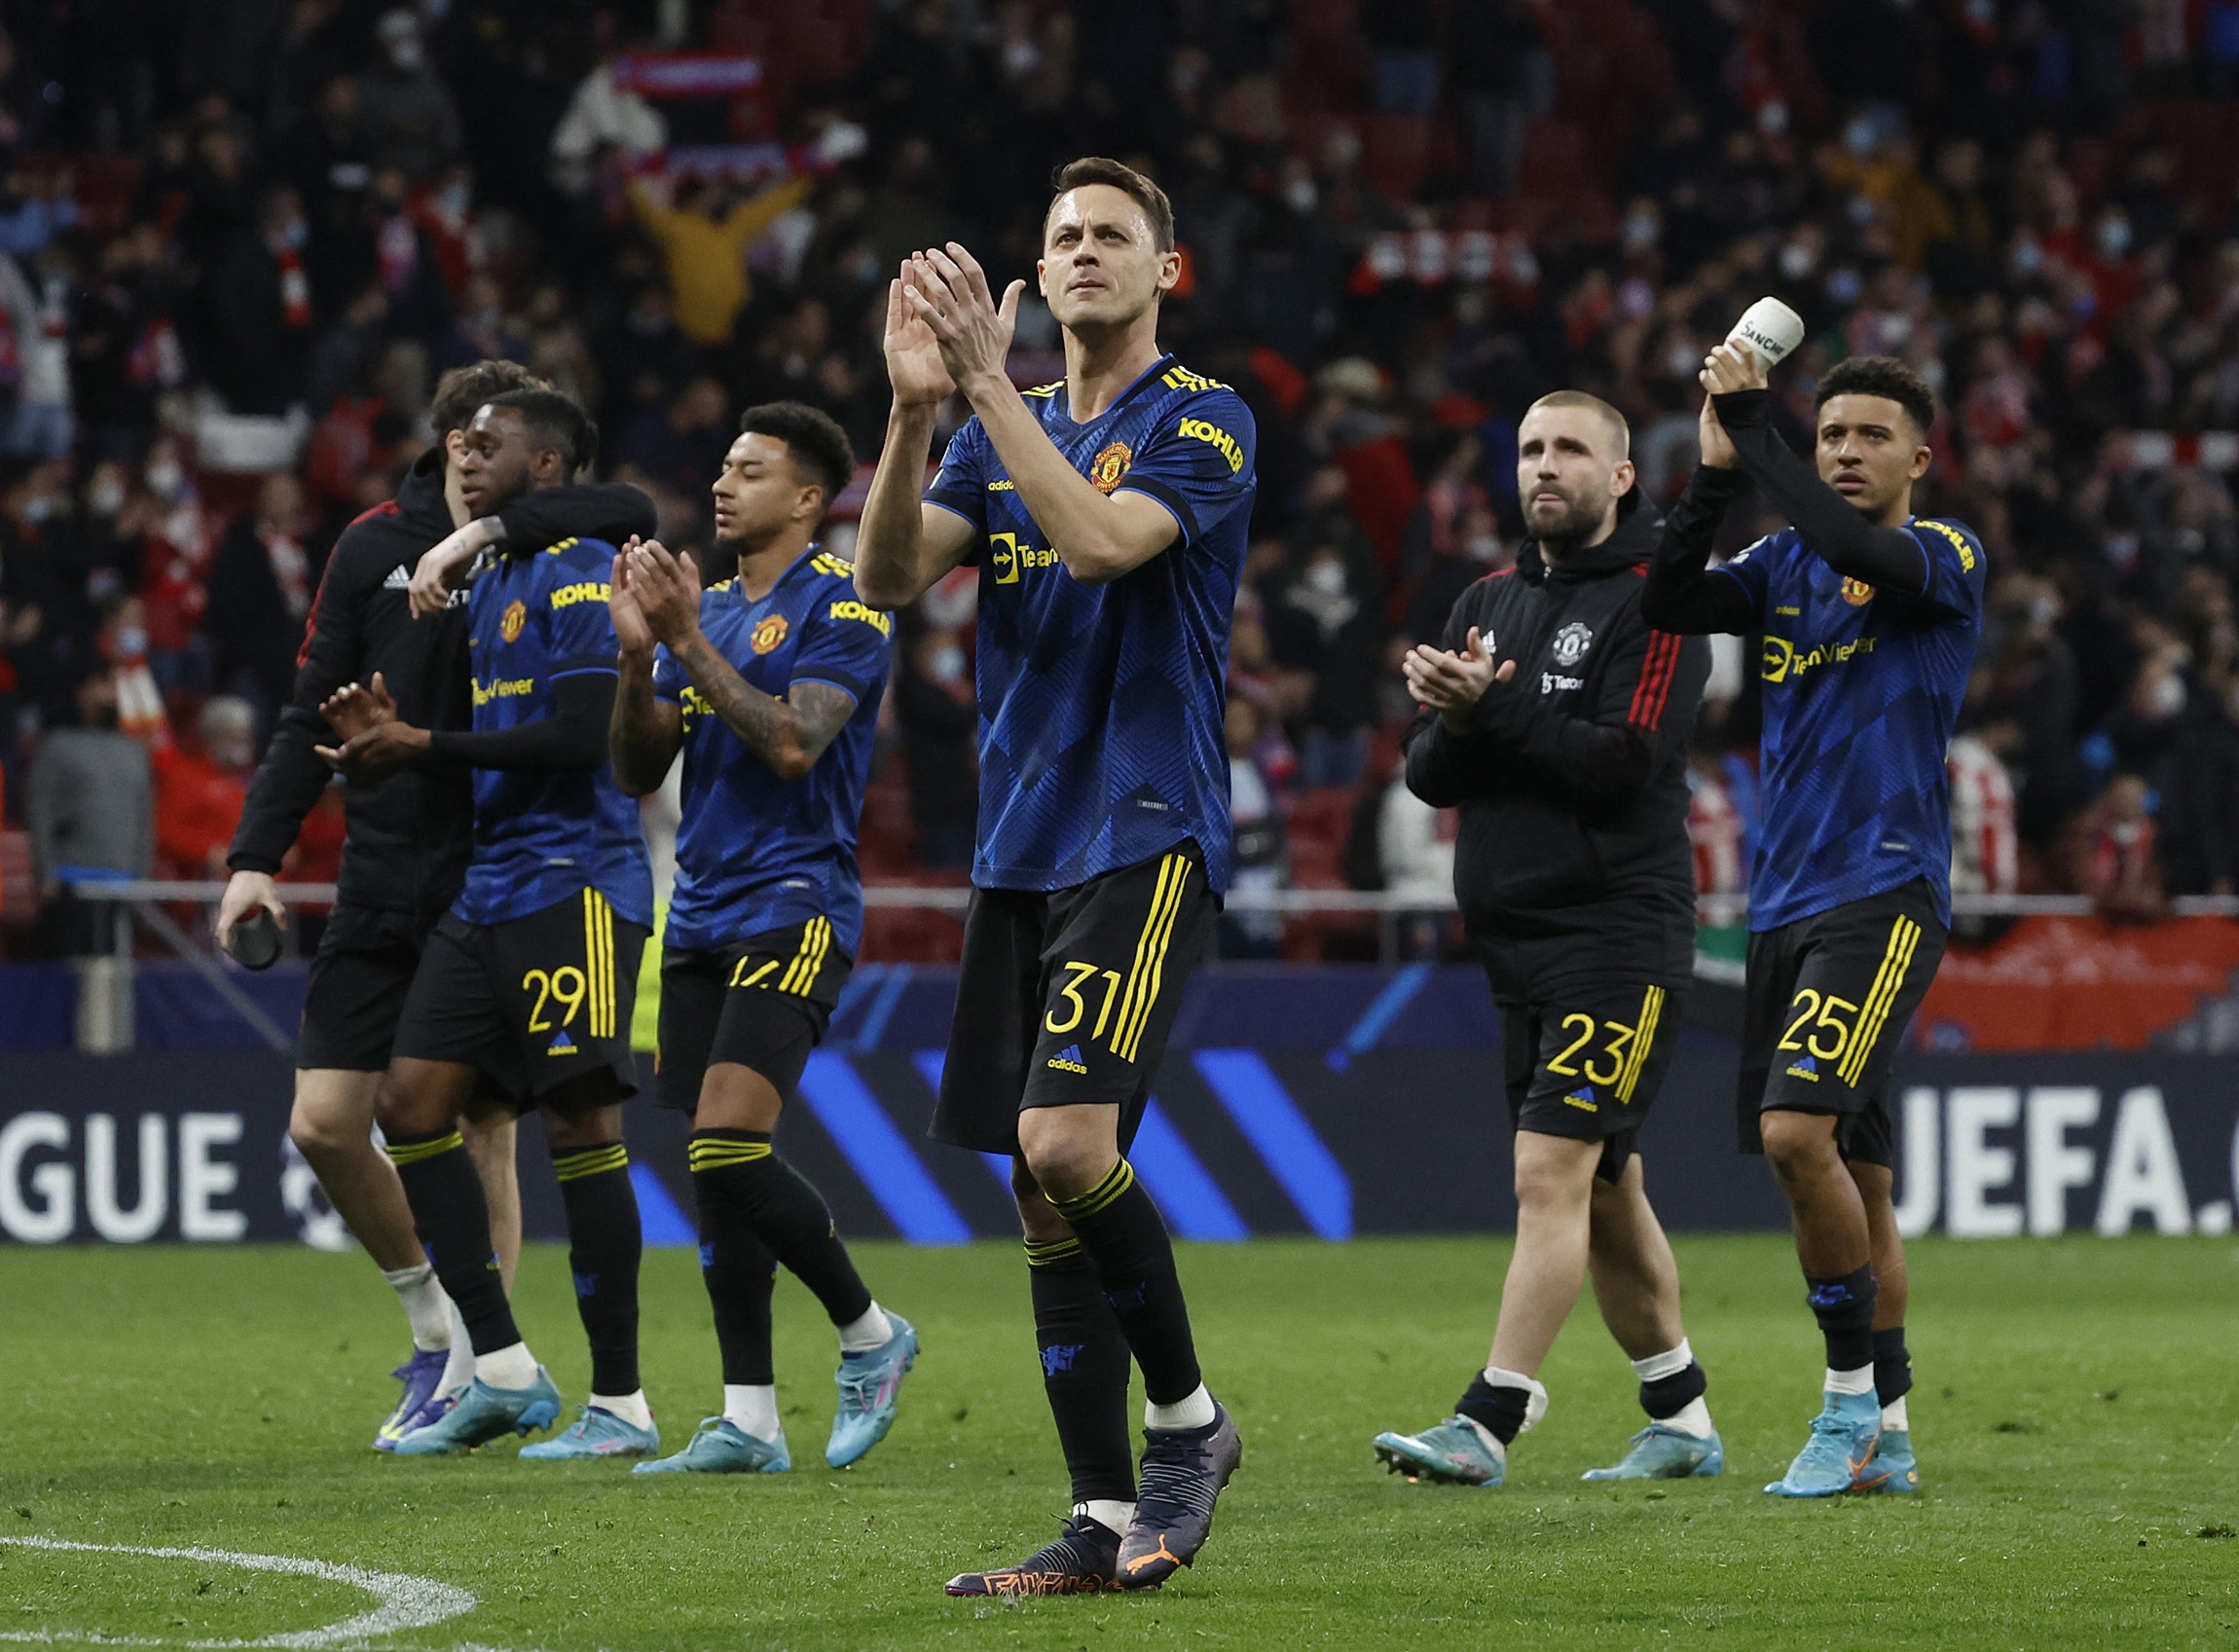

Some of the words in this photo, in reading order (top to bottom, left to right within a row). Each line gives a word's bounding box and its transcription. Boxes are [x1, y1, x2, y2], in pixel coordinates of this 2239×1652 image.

[550, 582, 612, 610] KOHLE
[829, 601, 891, 640] KOHLE
[522, 965, 586, 1033] 29
[1046, 961, 1121, 1041] 31
[1777, 988, 1859, 1060] 25
[1047, 1058, 1088, 1075] adidas
[1546, 1012, 1635, 1085] 23
[0, 1110, 247, 1245] GUE
[1893, 1084, 2239, 1239] UEFA.
